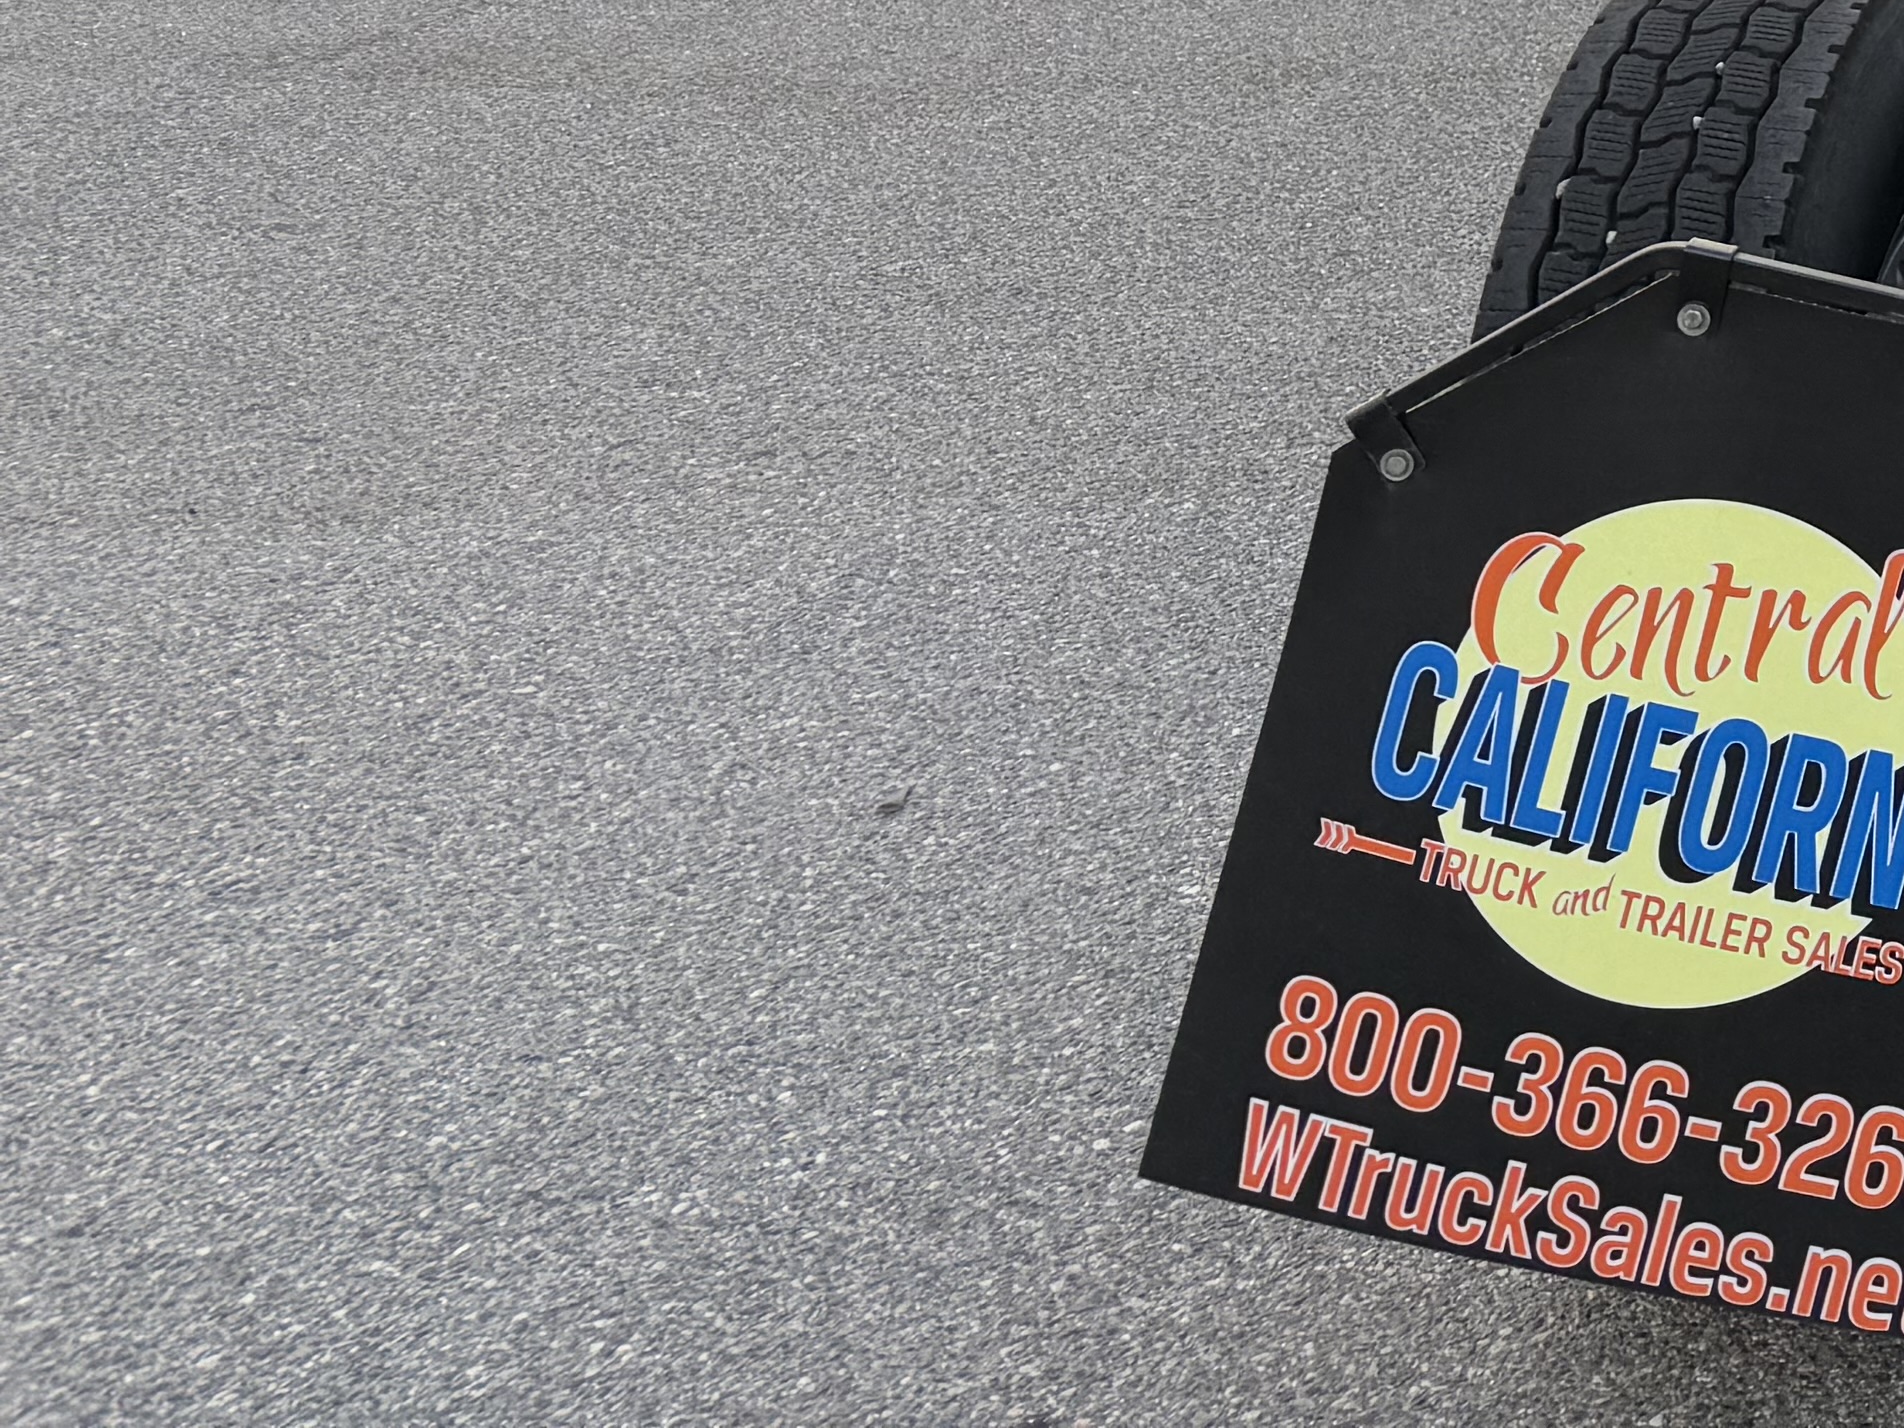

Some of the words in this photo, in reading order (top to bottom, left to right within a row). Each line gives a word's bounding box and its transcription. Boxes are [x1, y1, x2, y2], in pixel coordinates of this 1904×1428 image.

[1419, 838, 1544, 909] TRUCK
[1552, 870, 1614, 917] and
[1620, 889, 1771, 958] TRAILER
